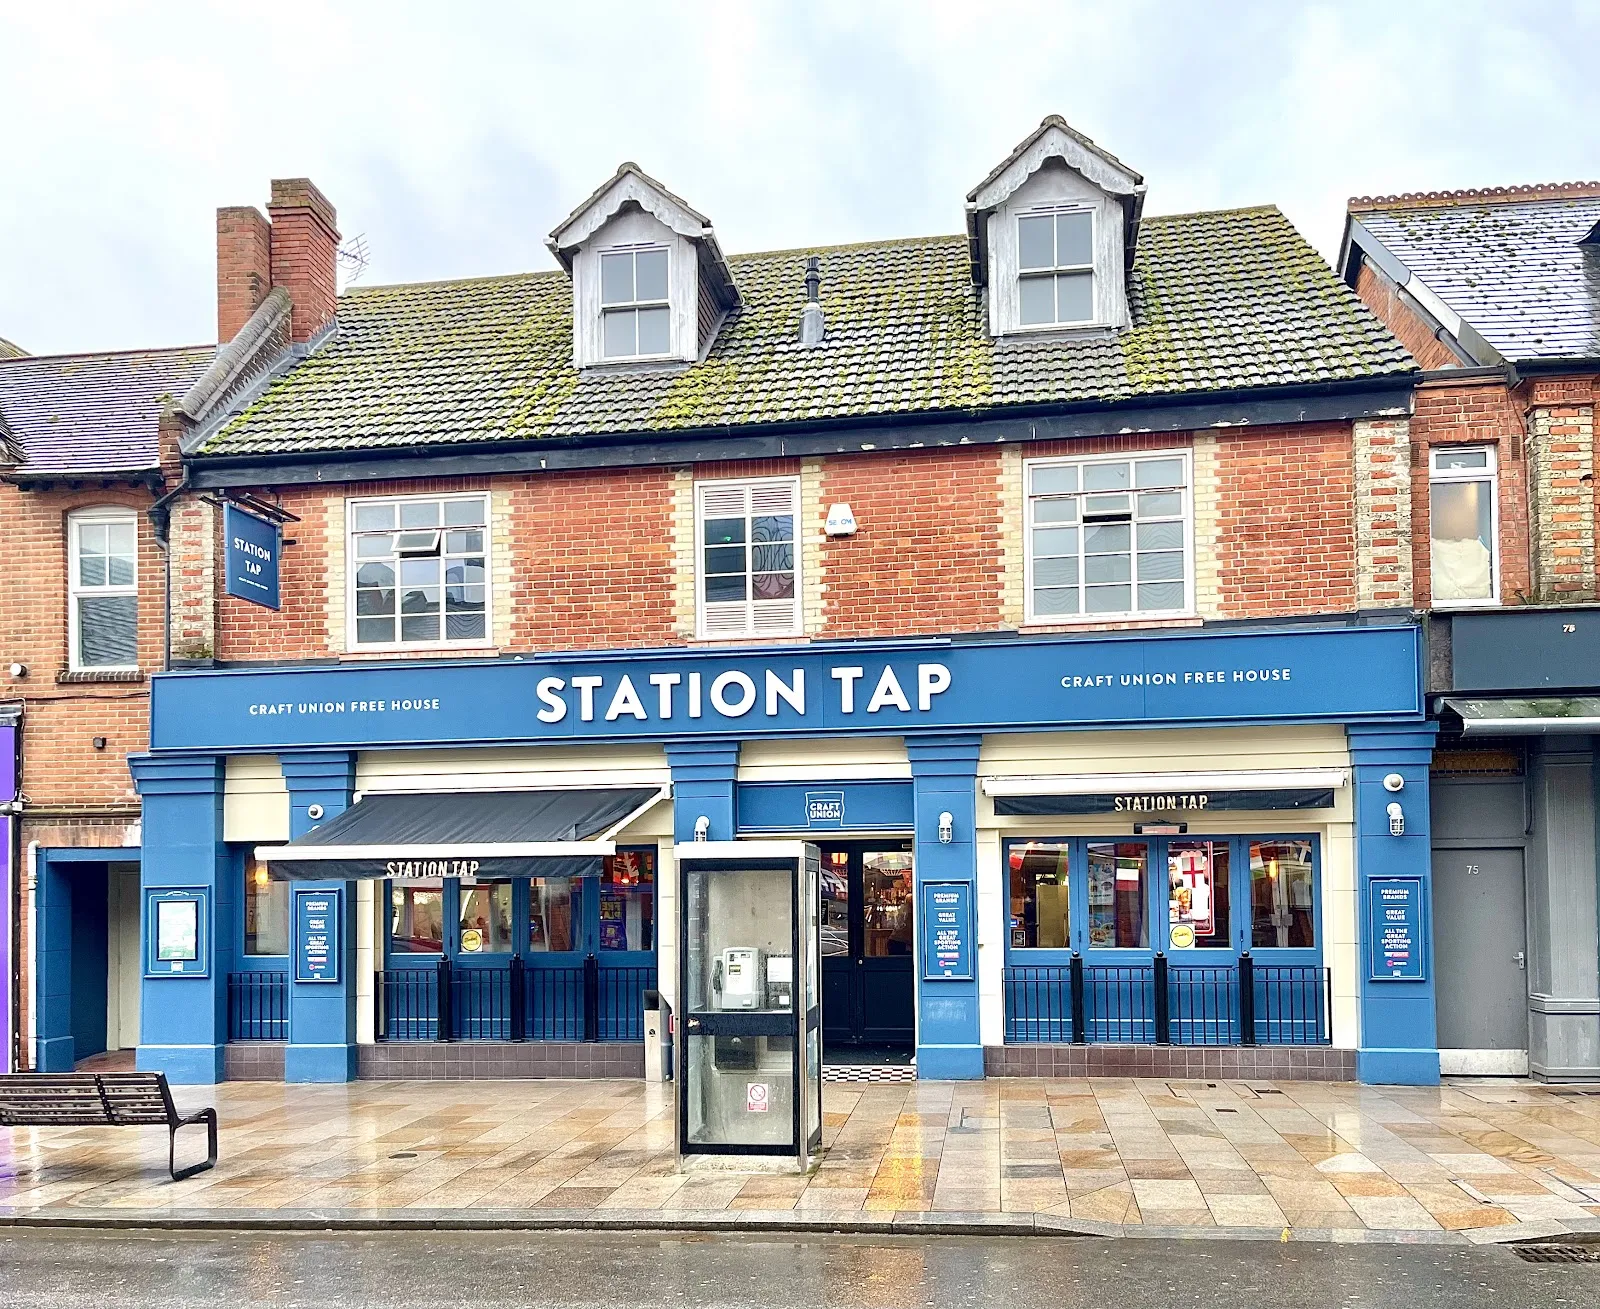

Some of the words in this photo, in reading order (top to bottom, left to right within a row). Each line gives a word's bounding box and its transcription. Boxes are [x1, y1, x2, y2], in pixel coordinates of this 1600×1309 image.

[234, 537, 271, 562] STATION
[245, 560, 262, 576] TAP
[1061, 675, 1114, 688] CRAFT
[1120, 672, 1177, 686] UNION
[1184, 671, 1226, 684] FREE
[1233, 668, 1291, 682] HOUSE
[536, 669, 805, 723] STATION
[831, 663, 952, 714] TAP
[249, 703, 293, 716] CRAFT
[298, 702, 346, 714] UNION
[351, 700, 387, 712] FREE
[391, 698, 441, 711] HOUSE
[810, 802, 840, 810] CRAFT
[1114, 795, 1176, 812] STATION
[1180, 794, 1208, 810] TAP
[810, 810, 840, 819] UNION
[386, 860, 448, 878] STATION
[451, 860, 479, 877] TAP
[1466, 865, 1479, 875] 75
